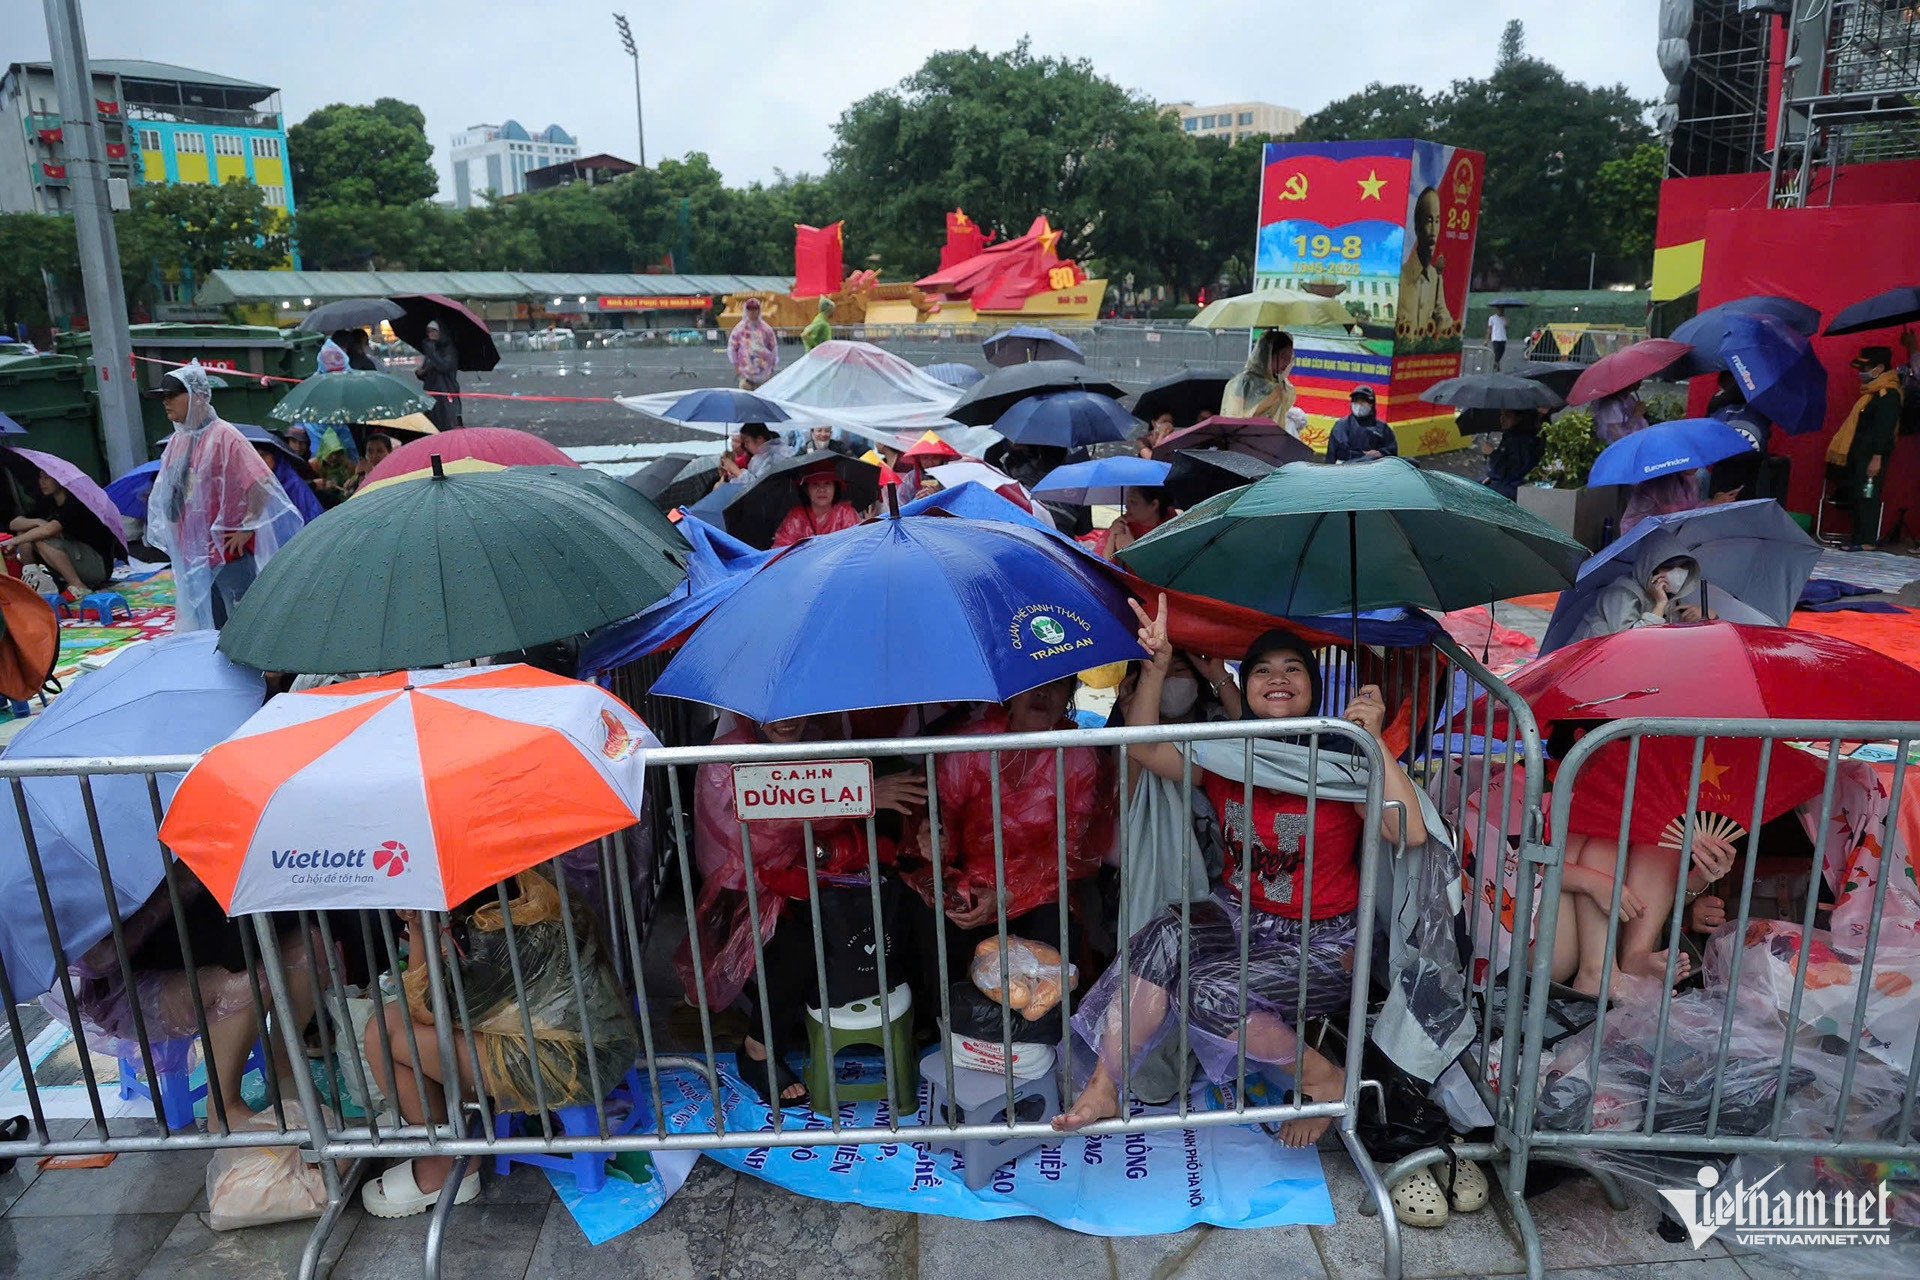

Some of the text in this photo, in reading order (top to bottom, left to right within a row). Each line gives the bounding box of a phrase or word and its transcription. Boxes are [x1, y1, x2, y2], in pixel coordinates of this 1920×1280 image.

[1295, 234, 1362, 259] 19-8
[1049, 267, 1075, 290] 80
[1025, 604, 1055, 614] DANH
[1076, 637, 1094, 649] AN
[771, 768, 832, 780] C.A.H.N
[744, 784, 863, 807] DỪNG LẠI
[271, 849, 366, 869] Vietlott
[291, 874, 305, 884] Cơ
[306, 873, 322, 885] hội
[354, 873, 374, 883] hơn
[1125, 1131, 1153, 1180] HÔNG
[1186, 1148, 1204, 1171] PHỐ
[1187, 1171, 1203, 1188] HÀ
[1187, 1188, 1206, 1208] NỘI
